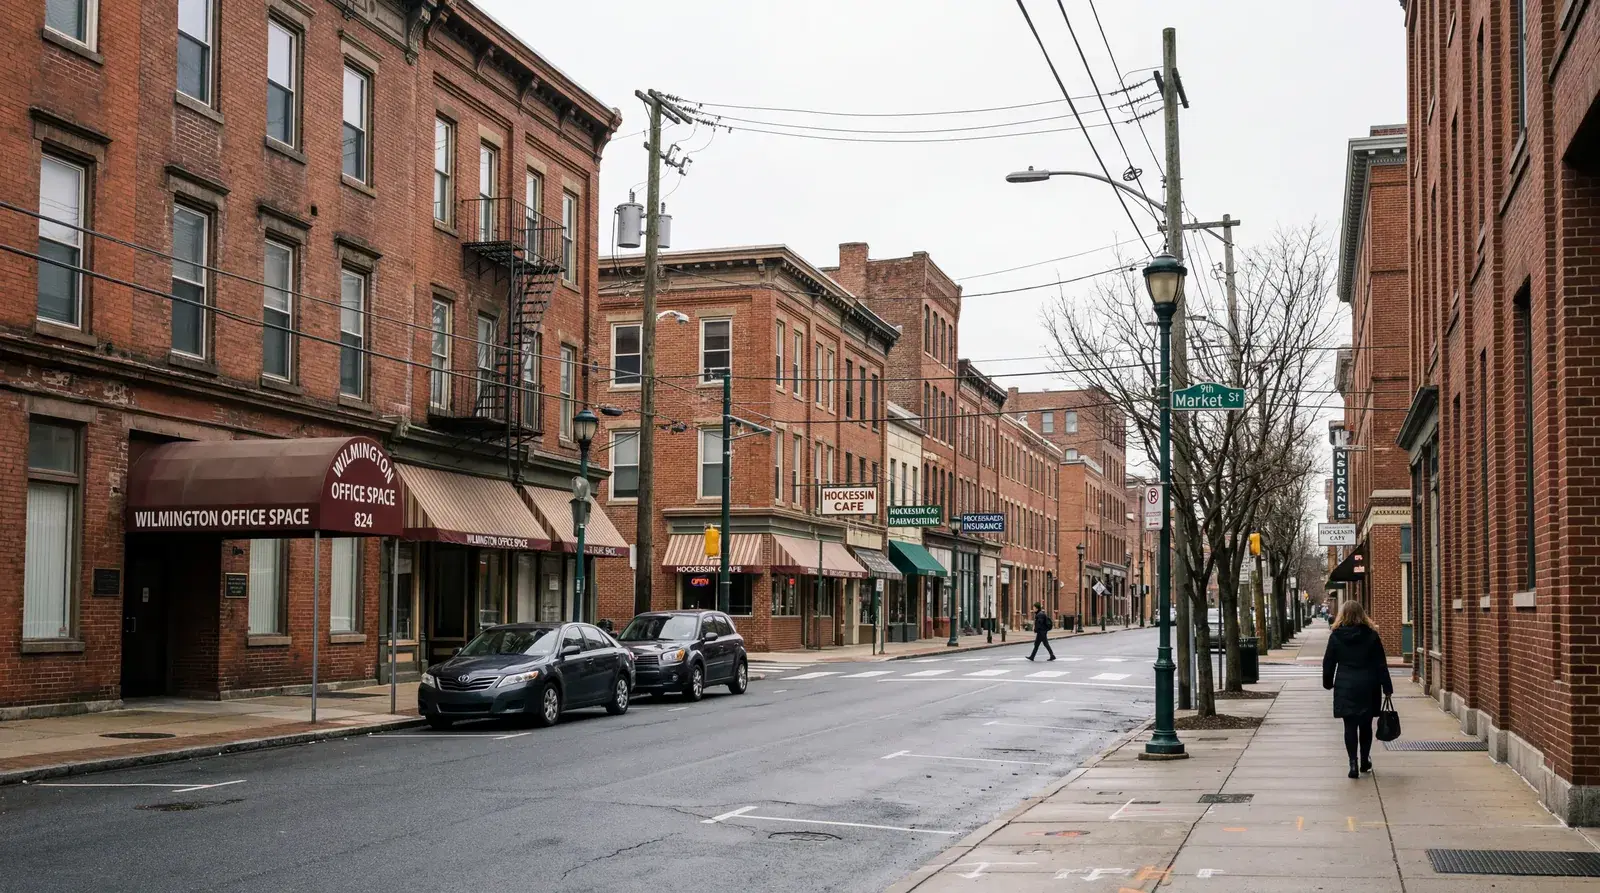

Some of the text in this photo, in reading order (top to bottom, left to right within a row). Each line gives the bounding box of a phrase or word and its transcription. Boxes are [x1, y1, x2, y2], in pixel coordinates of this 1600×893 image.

[1200, 384, 1214, 393] 9th
[1175, 392, 1240, 407] Market St
[332, 442, 394, 484] WILMINGTON
[331, 481, 395, 506] OFFICE SPACE
[824, 490, 875, 501] HOCKESSIN
[834, 501, 864, 511] CAFE
[135, 507, 310, 528] WILMINGTON OFFICE SPACE
[354, 511, 373, 528] 824
[963, 522, 1003, 530] INSURANCE
